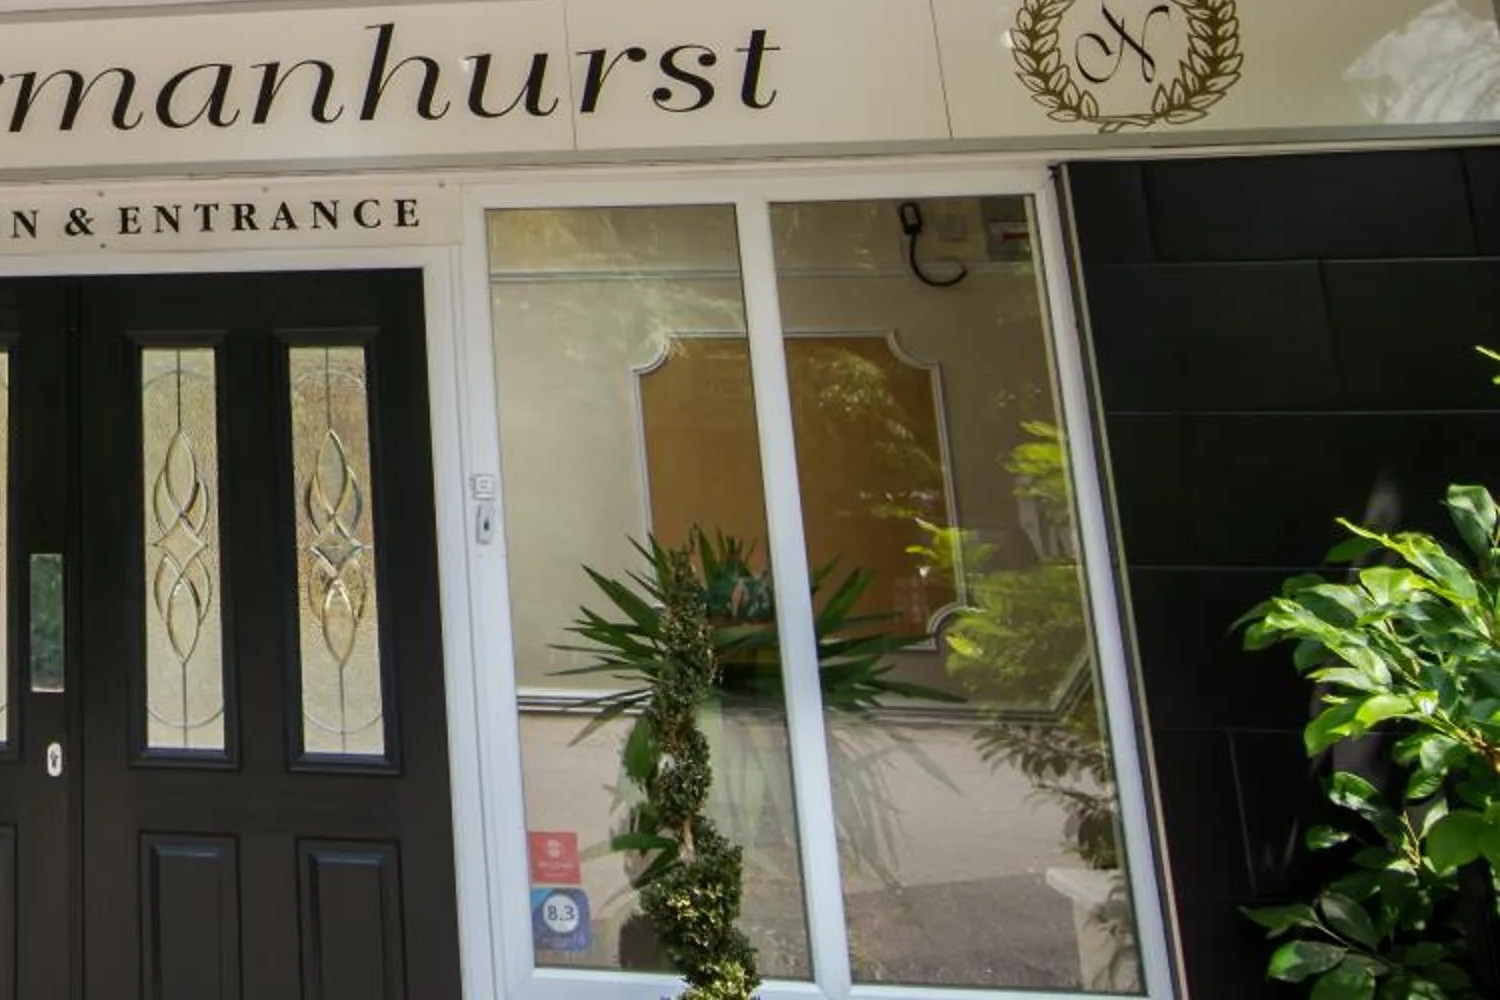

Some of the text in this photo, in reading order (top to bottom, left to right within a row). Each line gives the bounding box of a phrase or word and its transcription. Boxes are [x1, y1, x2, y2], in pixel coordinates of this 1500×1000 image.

[63, 206, 95, 238] &
[117, 198, 421, 236] ENTRANCE
[547, 904, 575, 921] 8.3
